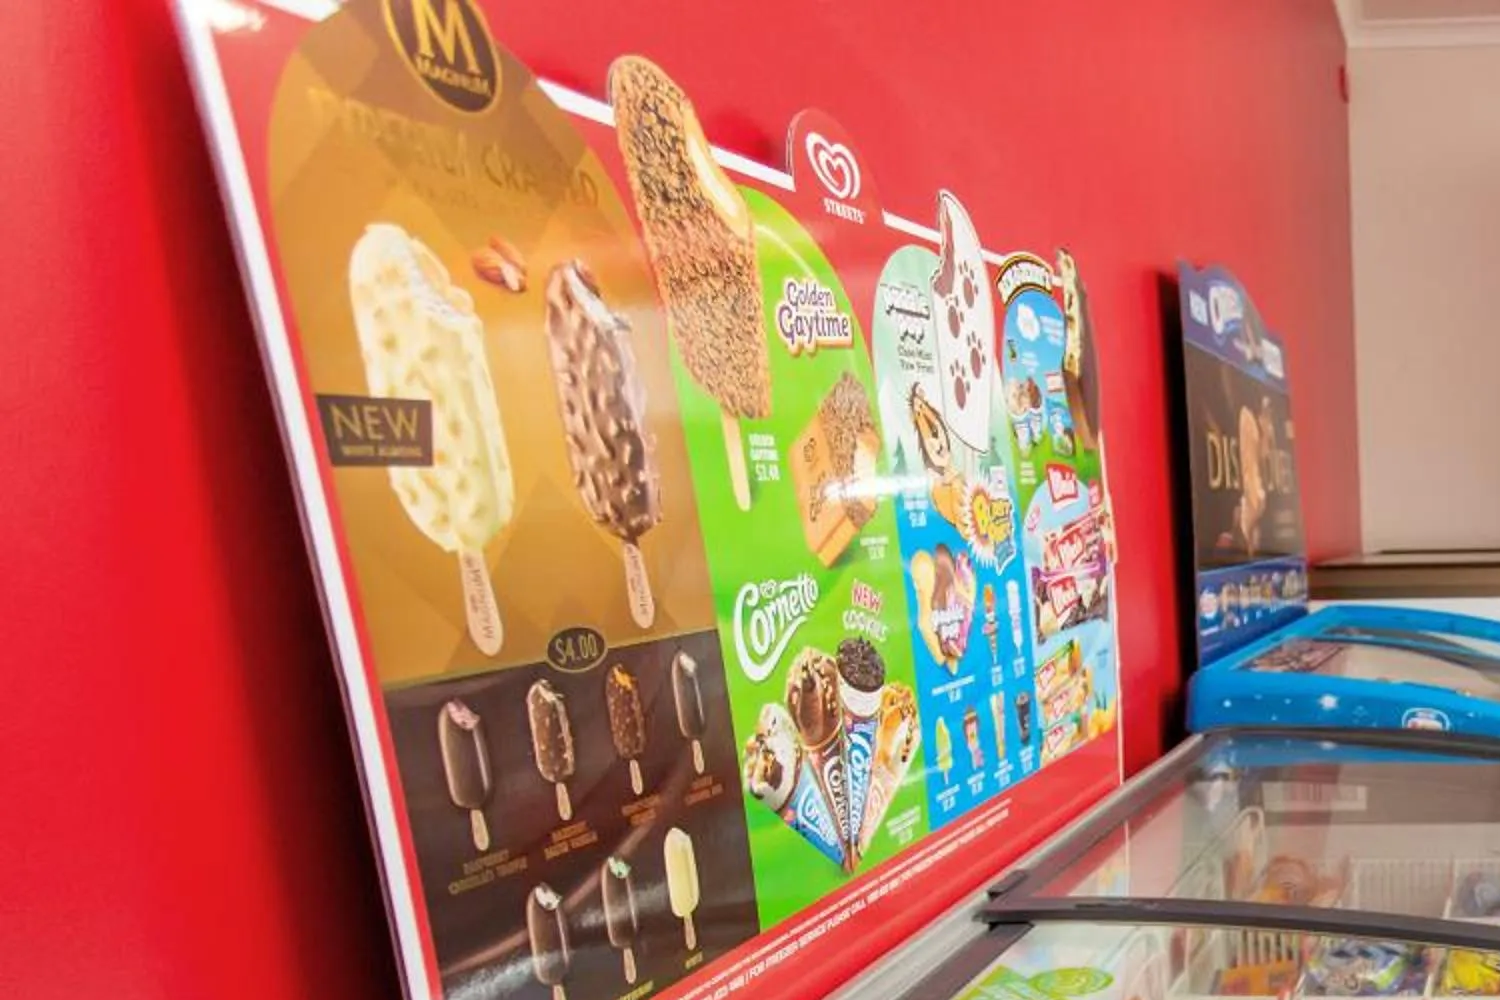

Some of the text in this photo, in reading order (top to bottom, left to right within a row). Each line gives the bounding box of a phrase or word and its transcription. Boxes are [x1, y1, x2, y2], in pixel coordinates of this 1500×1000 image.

[824, 198, 865, 225] STREETS
[784, 281, 835, 310] Golden
[777, 304, 852, 348] Gaytime
[330, 405, 418, 441] NEW
[734, 572, 819, 682] Cornetto
[555, 632, 598, 665] $4.00
